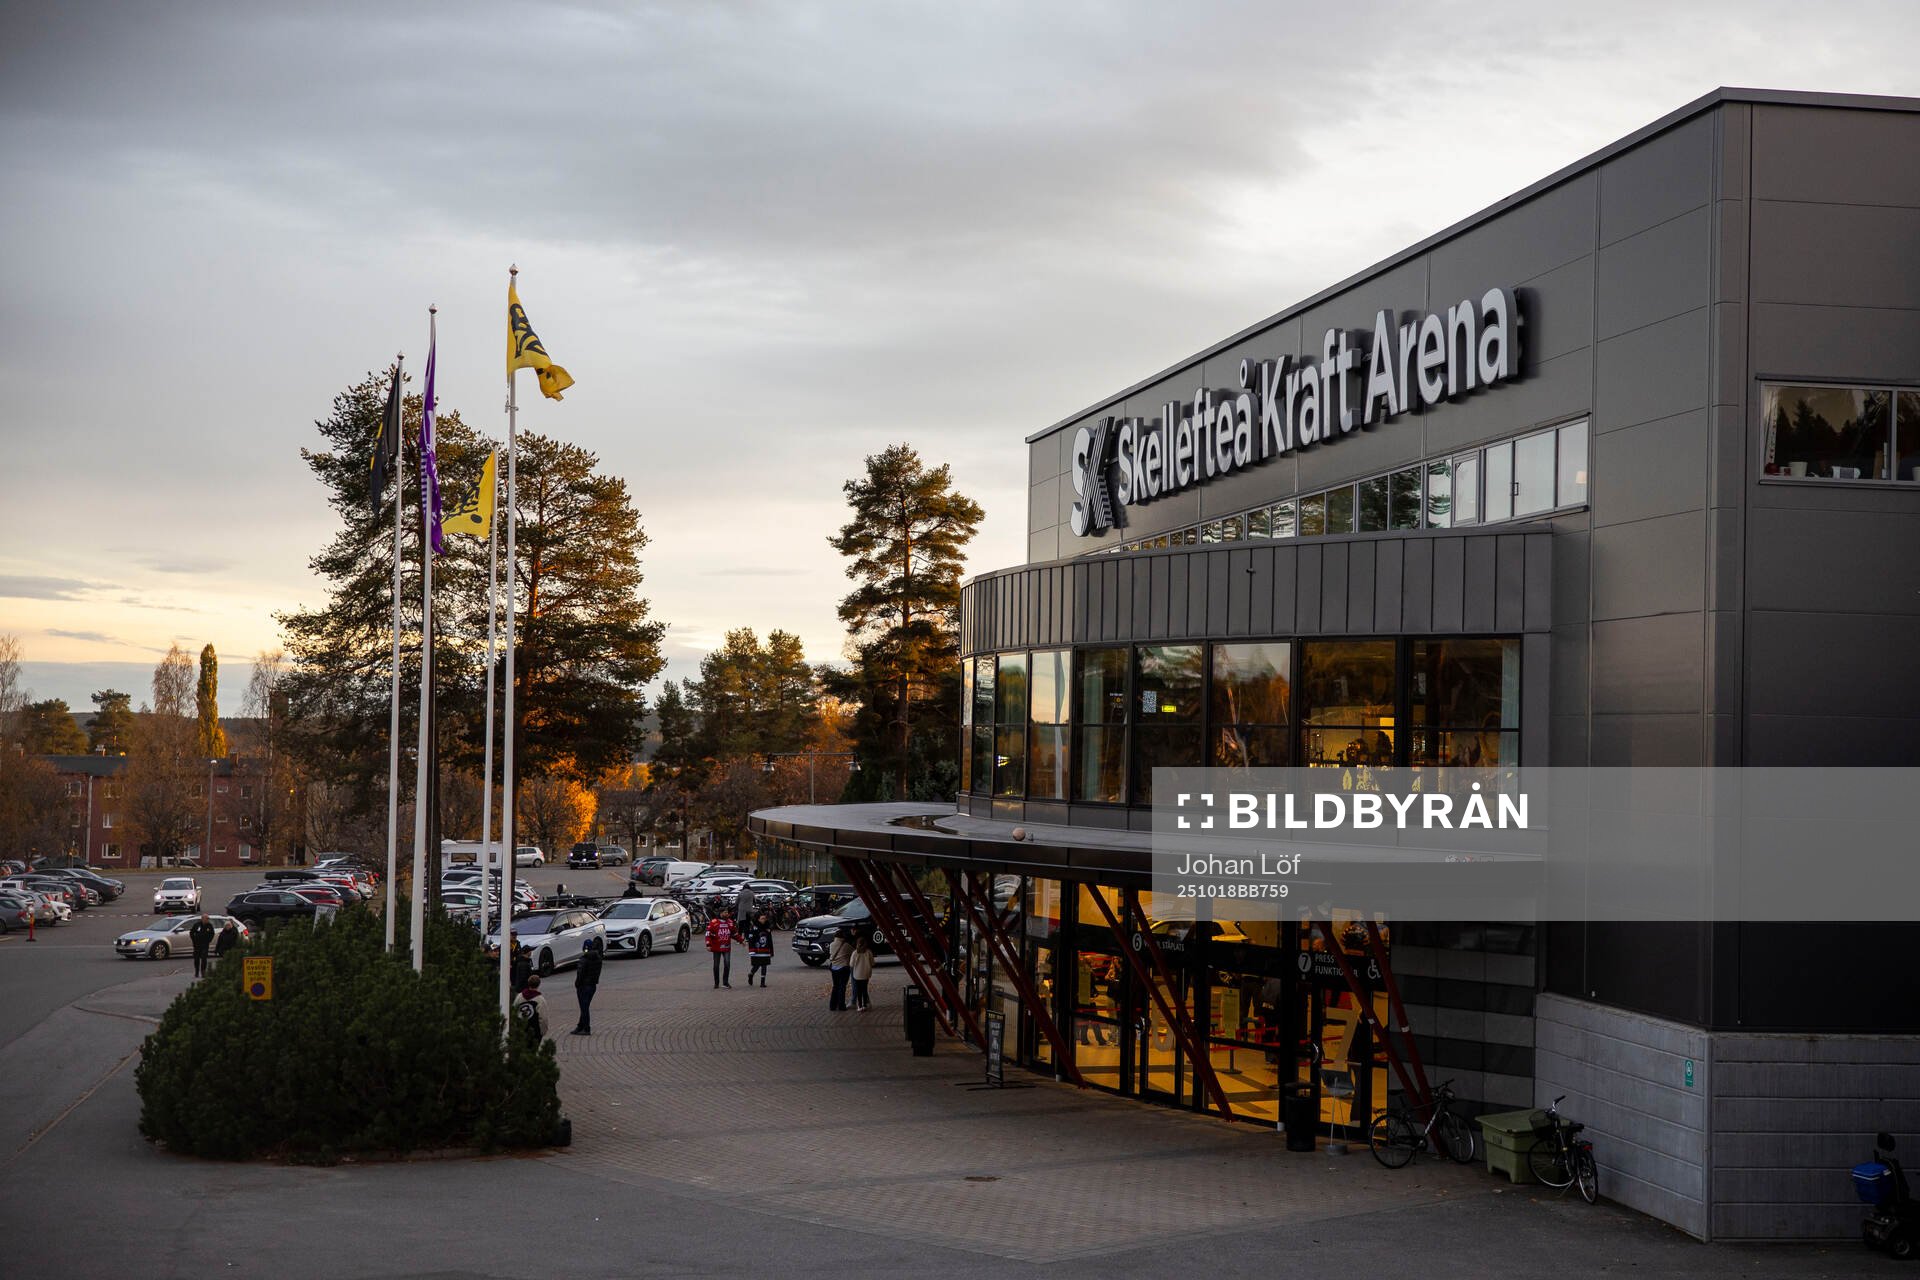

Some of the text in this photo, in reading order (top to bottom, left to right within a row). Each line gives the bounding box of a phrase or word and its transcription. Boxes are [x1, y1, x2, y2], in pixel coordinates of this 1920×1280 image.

[1118, 358, 1254, 506] Skellefteå
[1262, 329, 1357, 460] Kraft
[1364, 287, 1516, 424] Arena
[1315, 953, 1335, 963] PRESS
